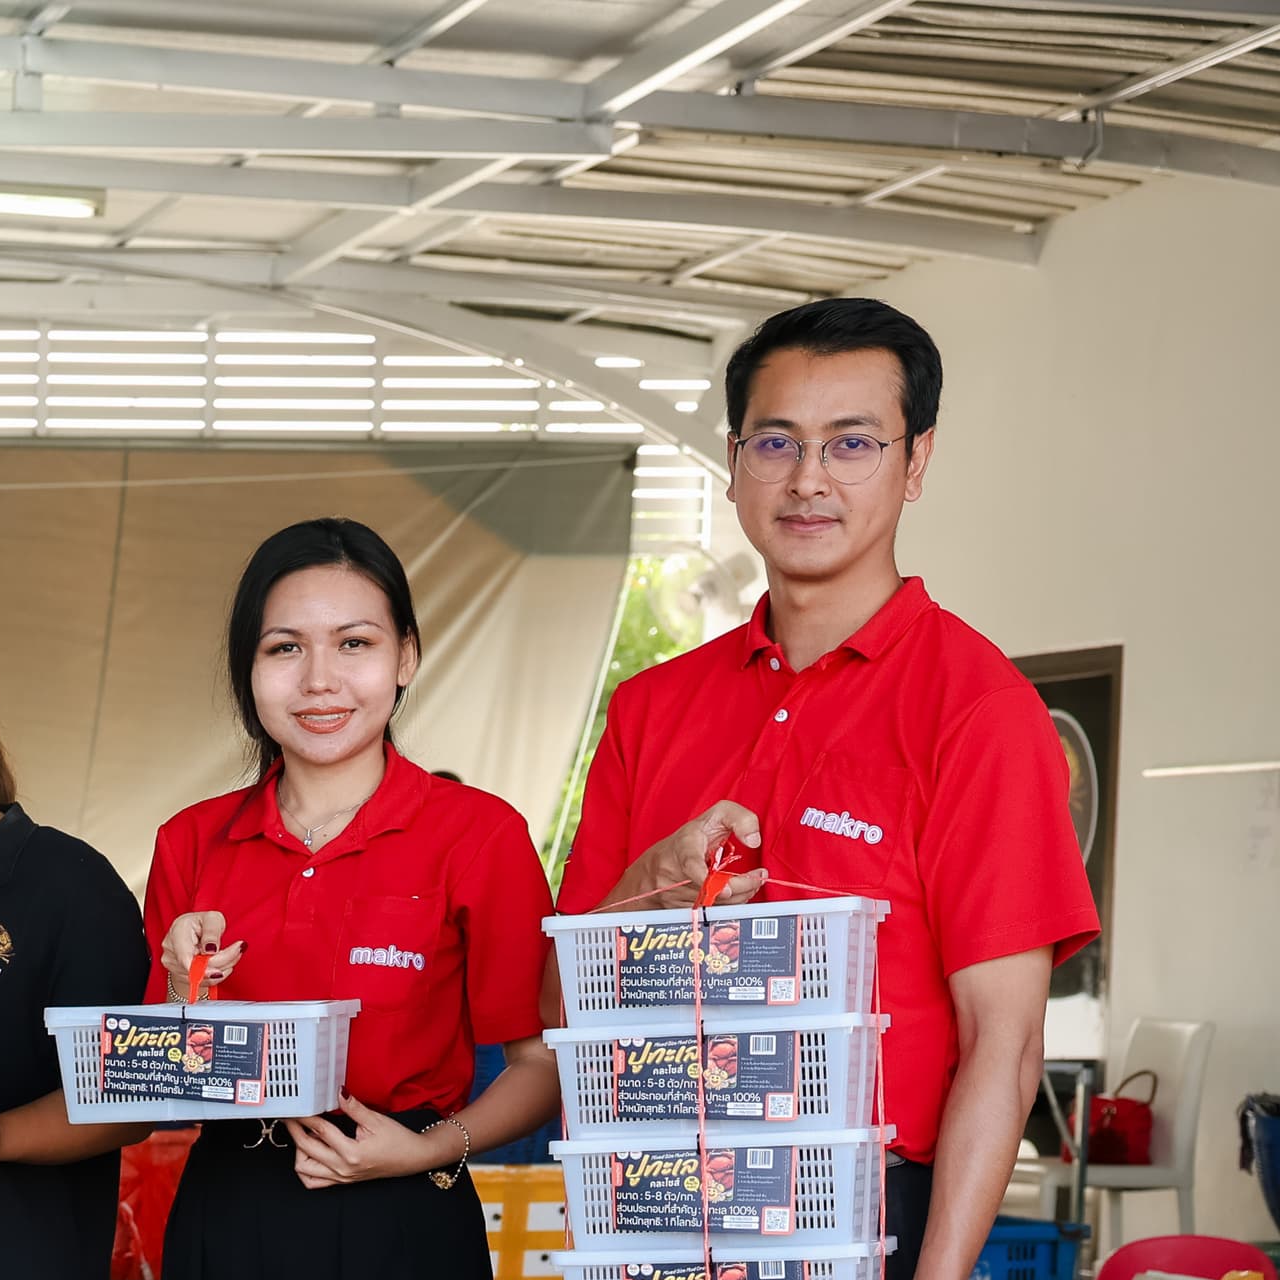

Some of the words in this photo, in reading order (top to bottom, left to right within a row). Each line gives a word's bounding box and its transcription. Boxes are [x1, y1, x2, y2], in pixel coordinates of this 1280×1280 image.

[800, 807, 883, 844] makro
[349, 944, 425, 971] makro
[620, 965, 642, 974] ขนาด
[649, 965, 666, 973] 5-8
[669, 964, 695, 975] ตัว/กก
[621, 975, 702, 987] ส่วนประกอบที่สำคั
[734, 977, 762, 987] 100%
[675, 987, 707, 1000] กิโลกม
[114, 1026, 181, 1055] ปูทะเล
[104, 1058, 126, 1066] ขนาด
[132, 1058, 148, 1068] 5-8
[208, 1078, 232, 1087] 100%
[617, 1078, 640, 1088] ขนาด
[648, 1079, 665, 1087] 5-8
[733, 1092, 760, 1102] 100%
[673, 1102, 705, 1113] กิโลกรั
[625, 1155, 698, 1187] ปูทะเล
[616, 1191, 638, 1200] ขนาด
[645, 1191, 661, 1200] 5-8
[702, 1206, 727, 1215] ทะเล
[730, 1206, 757, 1215] 100%
